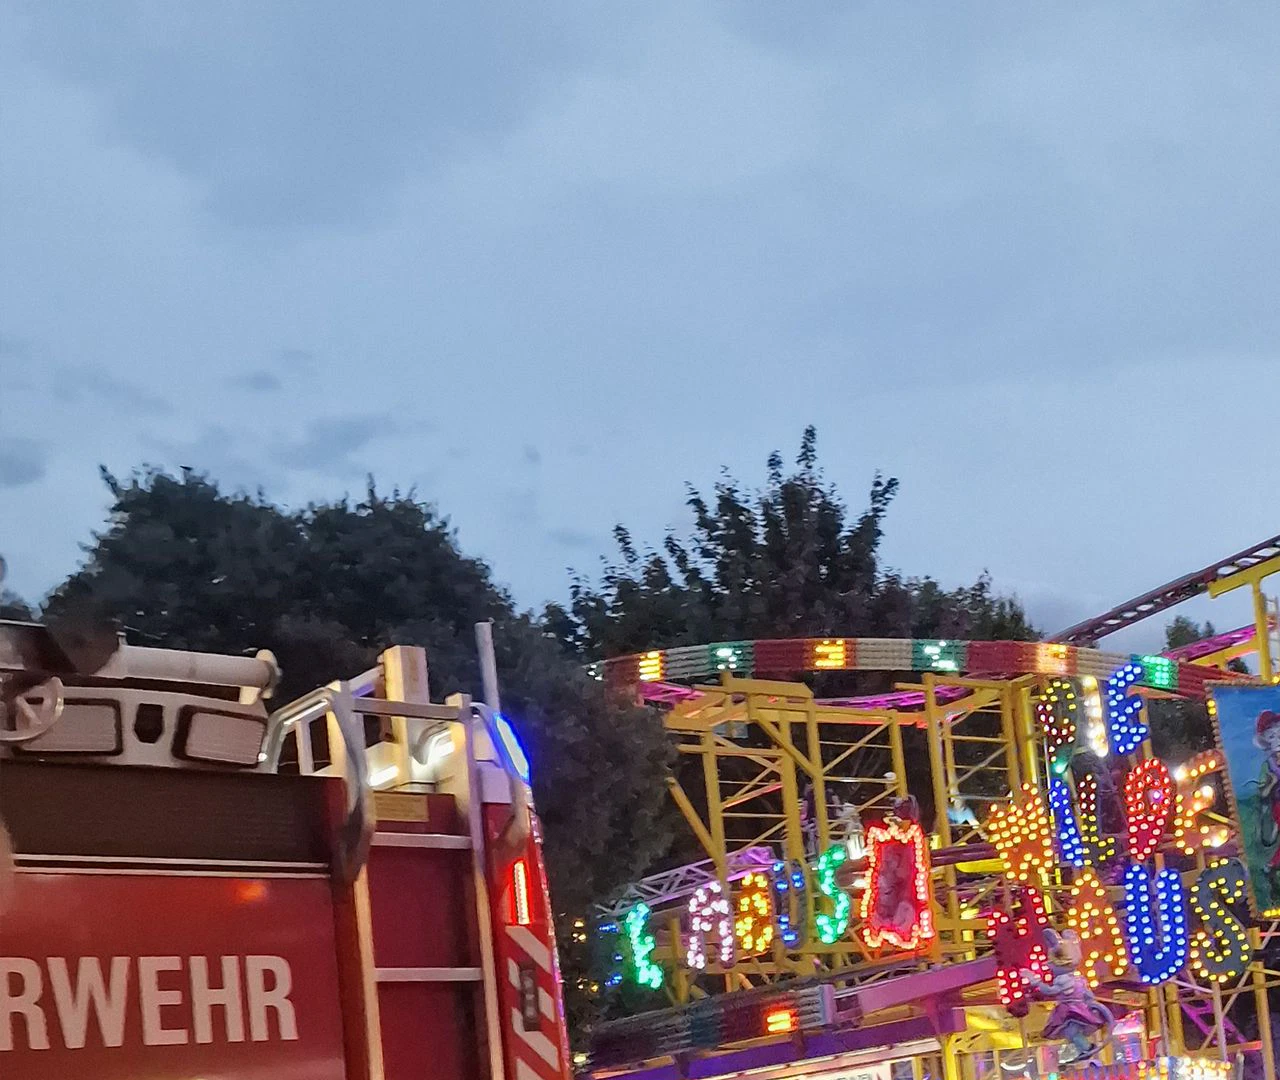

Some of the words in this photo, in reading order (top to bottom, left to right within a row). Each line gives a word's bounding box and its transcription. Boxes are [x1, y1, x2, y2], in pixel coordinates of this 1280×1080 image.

[984, 750, 1238, 882] WILDE
[685, 842, 852, 971] MAUS
[0, 955, 299, 1051] RWEHR
